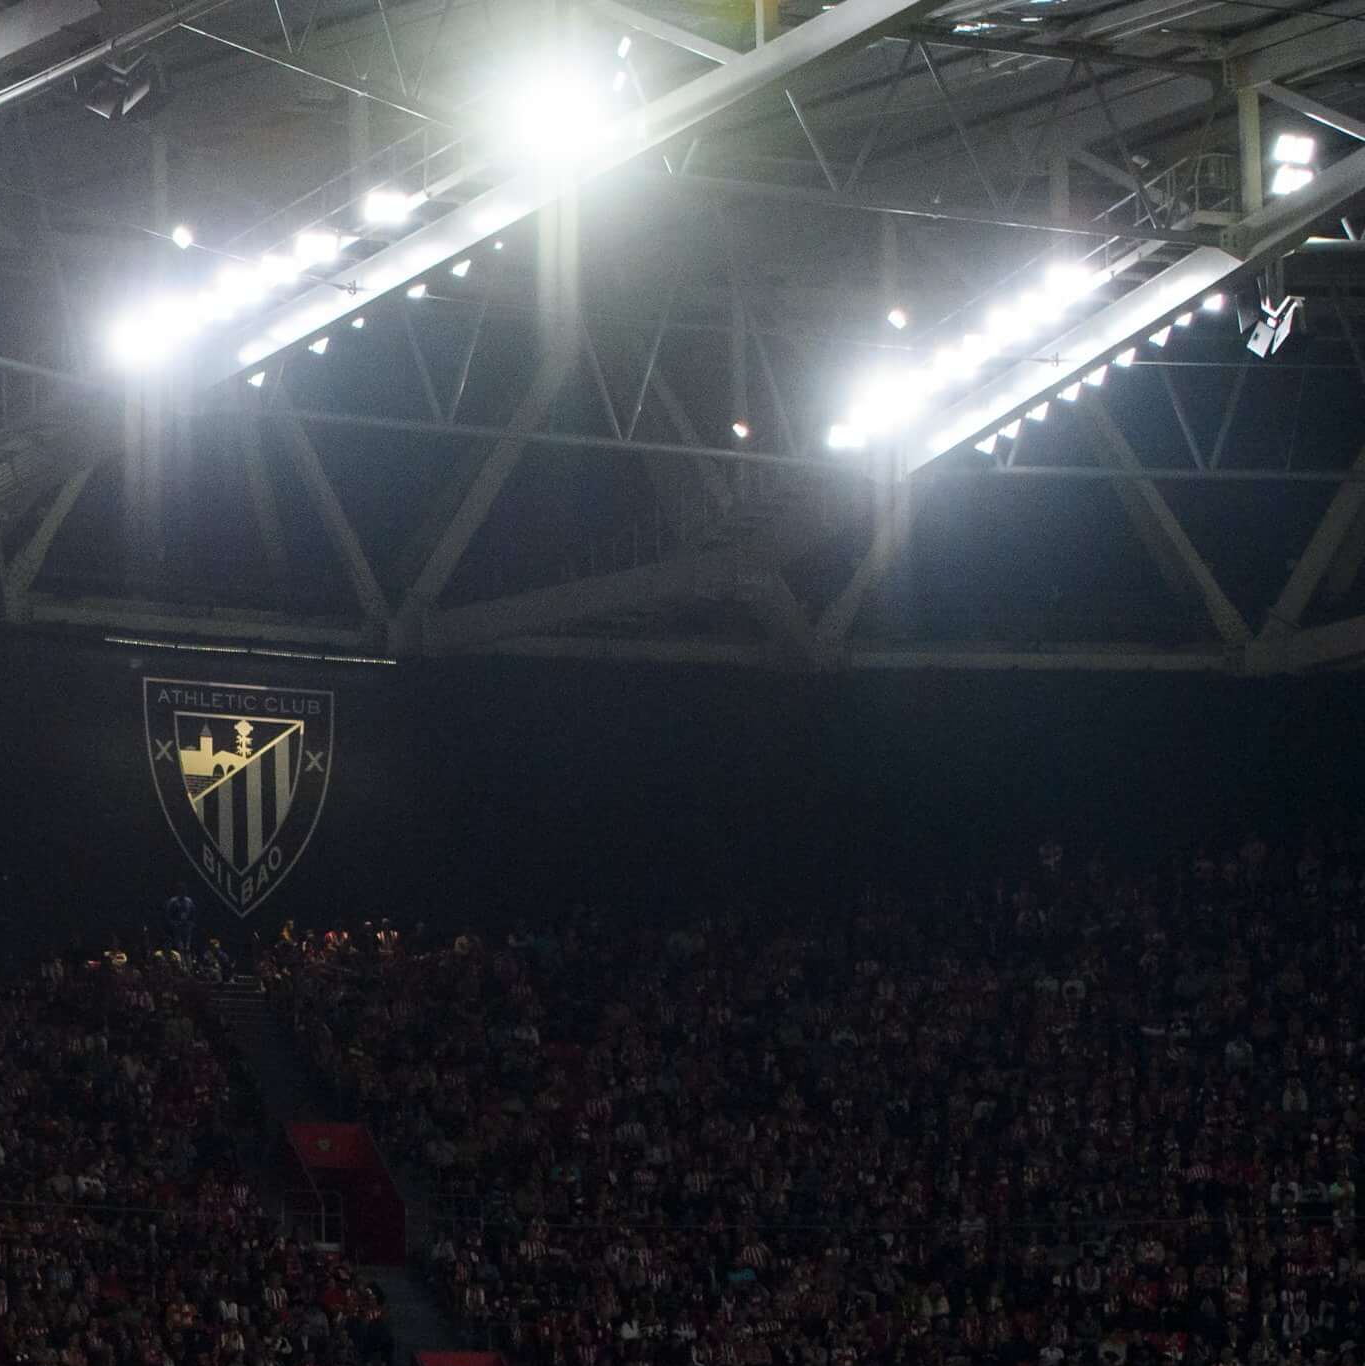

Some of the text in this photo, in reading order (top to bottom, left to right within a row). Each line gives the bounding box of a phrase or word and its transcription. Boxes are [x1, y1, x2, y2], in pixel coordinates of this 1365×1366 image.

[157, 688, 320, 714] ATHLETIC CLUB
[203, 846, 282, 905] BILBAO
